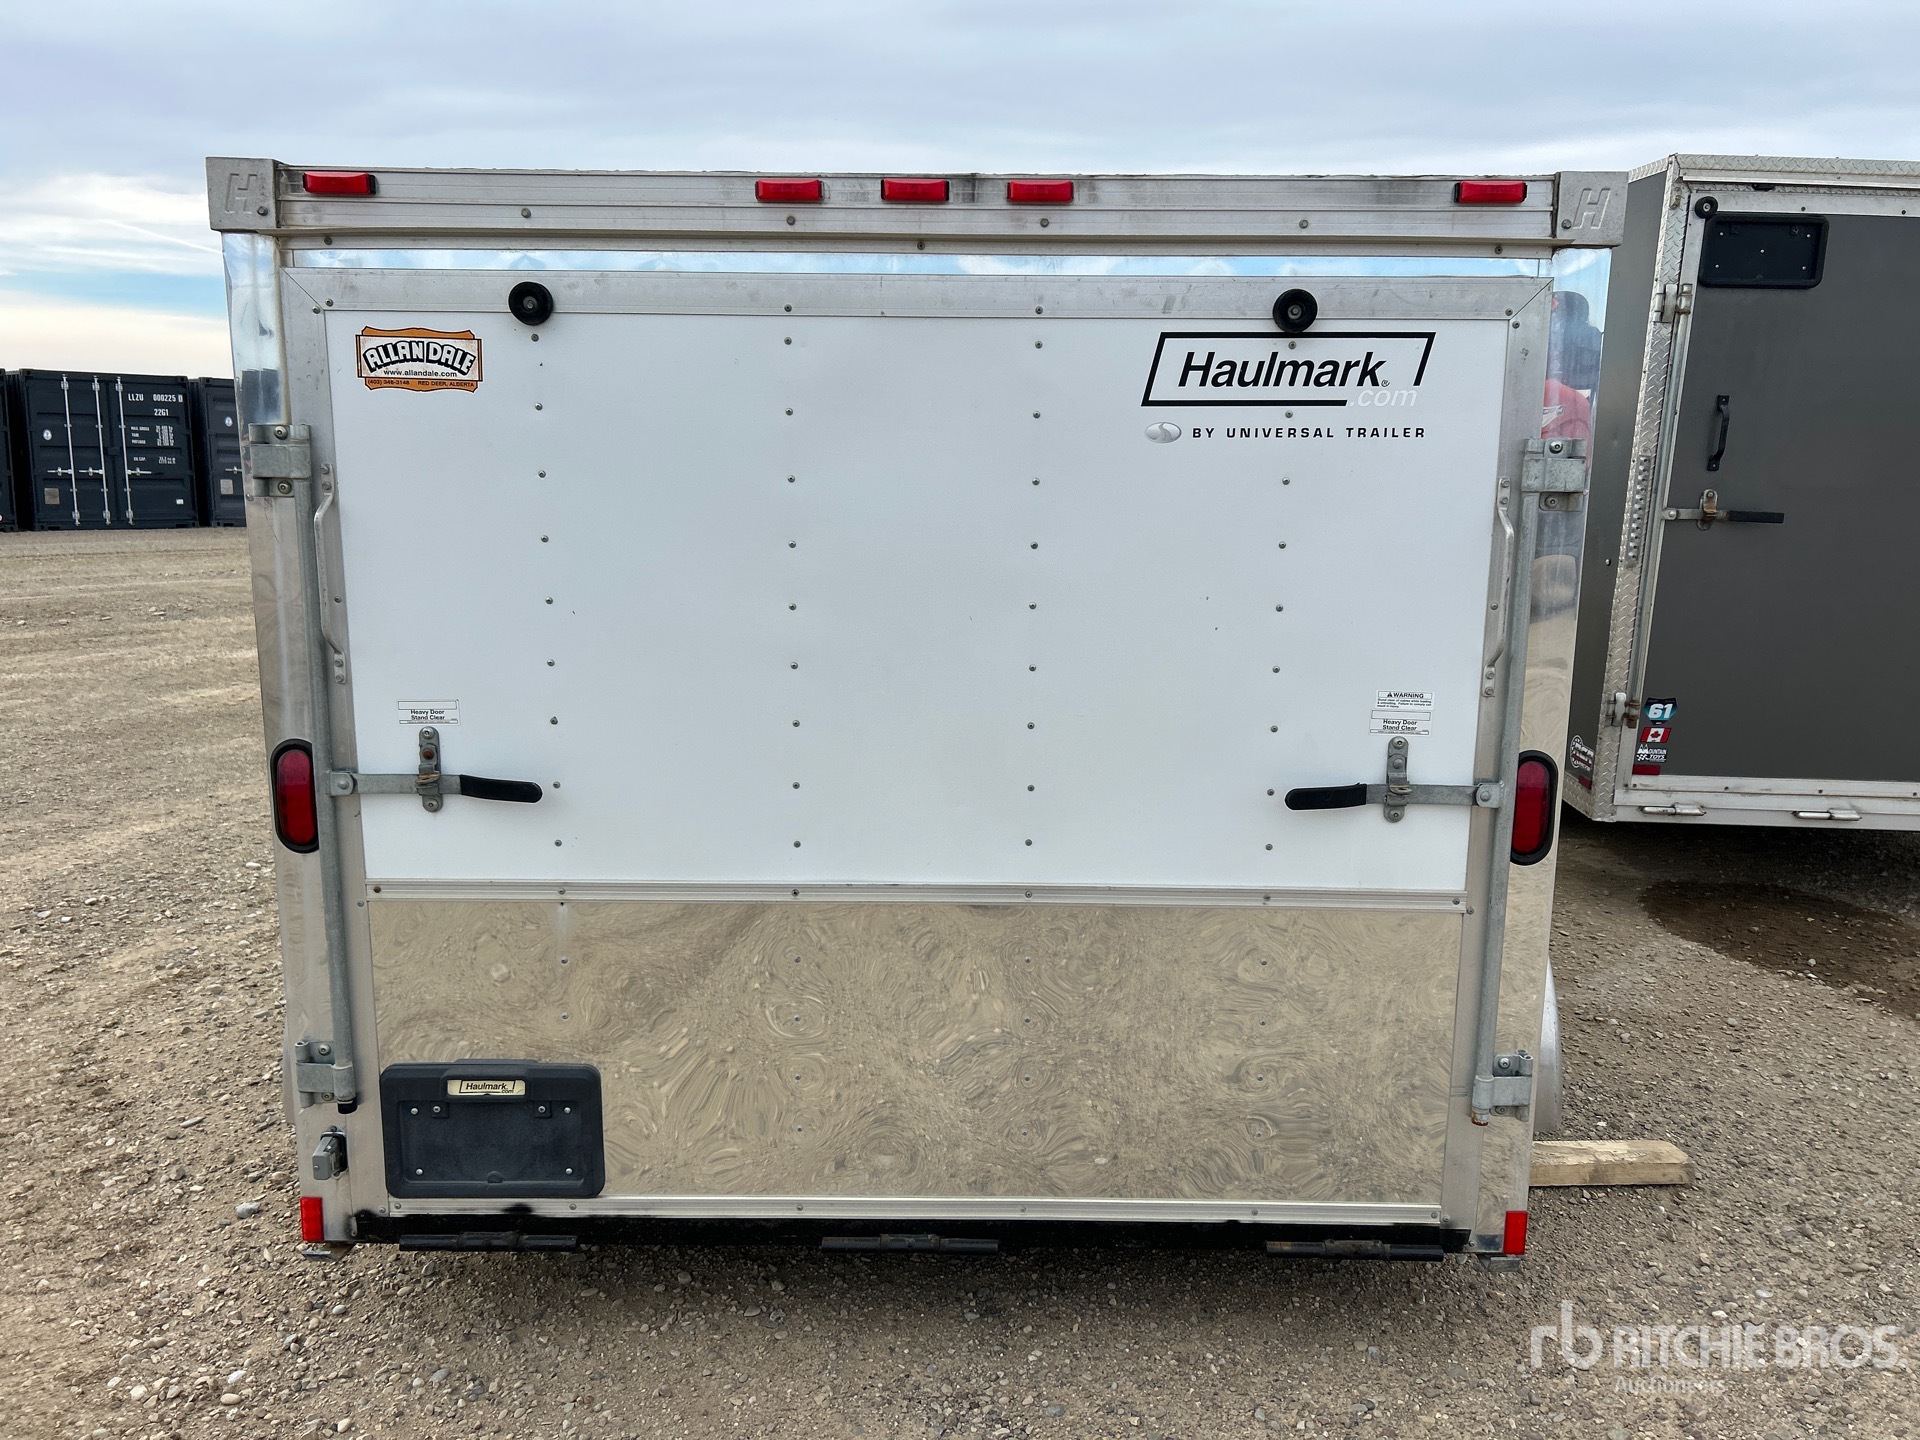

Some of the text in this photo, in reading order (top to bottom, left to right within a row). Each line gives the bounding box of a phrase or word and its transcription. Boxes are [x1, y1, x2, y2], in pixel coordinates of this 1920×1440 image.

[383, 369, 457, 377] www.allandale.com
[1178, 351, 1387, 387] Haulmark
[1192, 427, 1426, 438] BY UNIVERSAL TRAILER
[1648, 703, 1673, 719] 61
[465, 1082, 507, 1090] Haulmark
